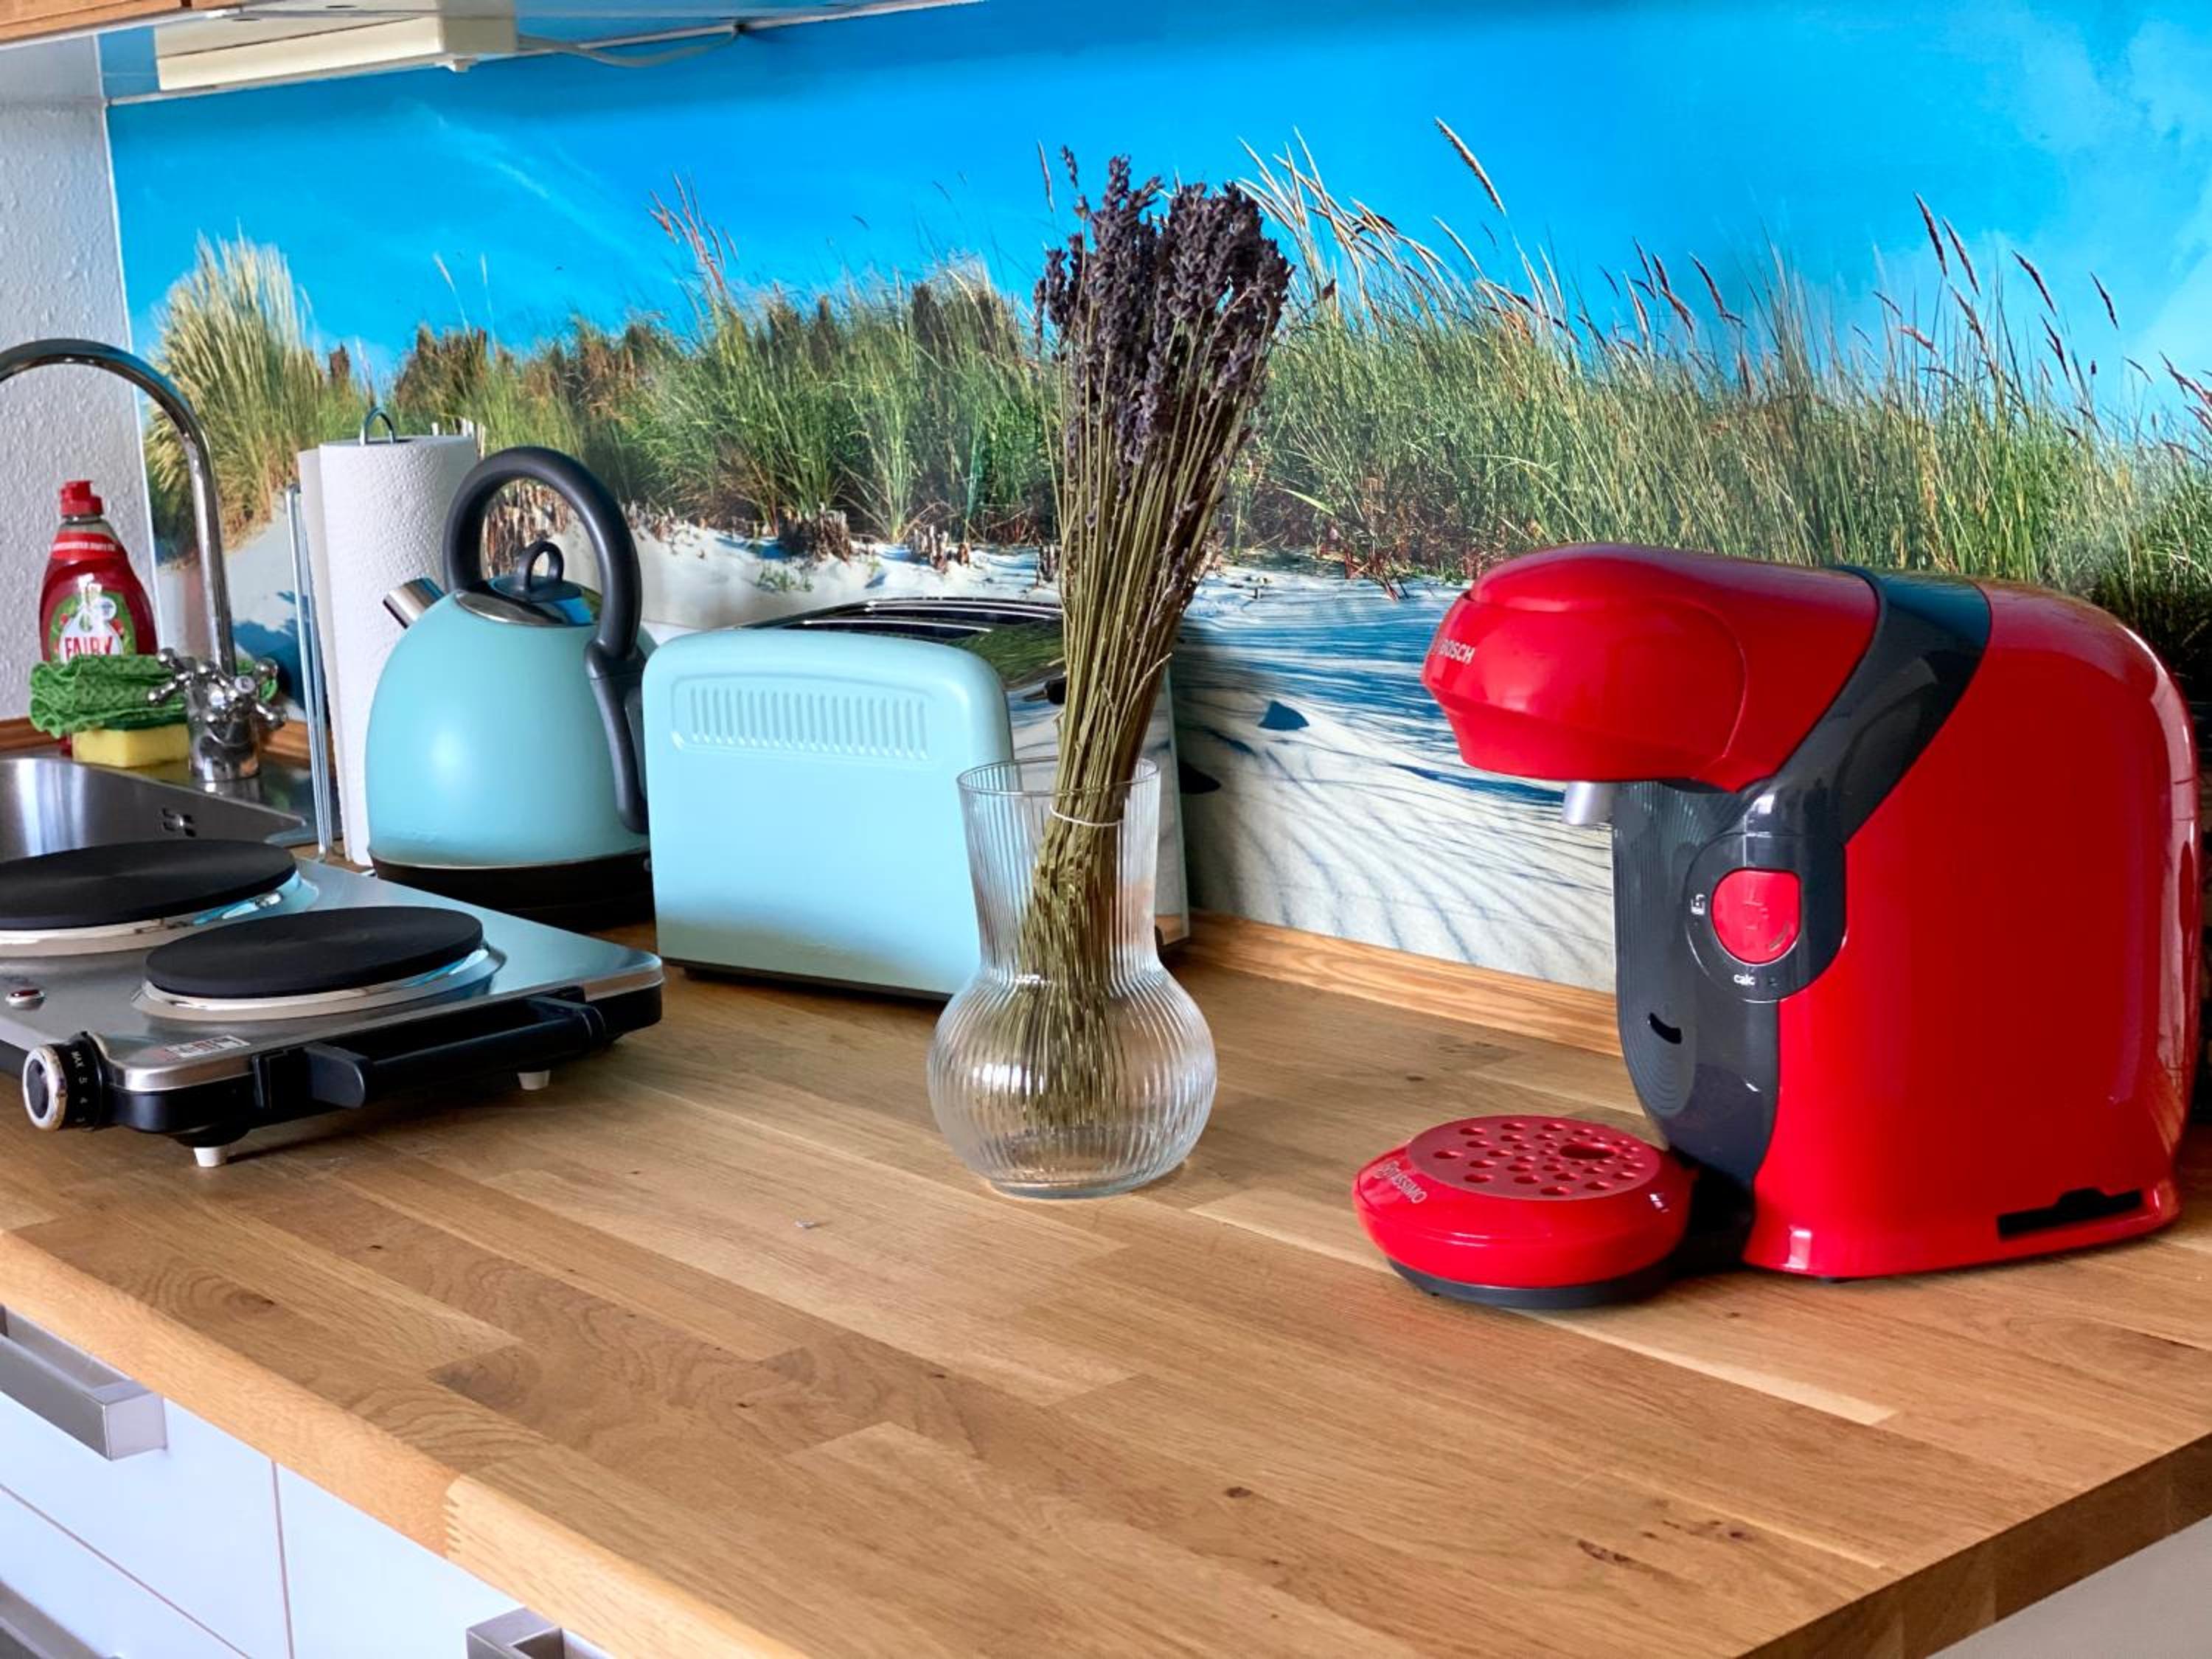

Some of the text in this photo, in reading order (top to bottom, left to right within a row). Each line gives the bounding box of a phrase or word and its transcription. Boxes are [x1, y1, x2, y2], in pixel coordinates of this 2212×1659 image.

[65, 636, 113, 658] FAIRY
[1439, 637, 1475, 664] BOSCH
[1733, 974, 1756, 985] calc
